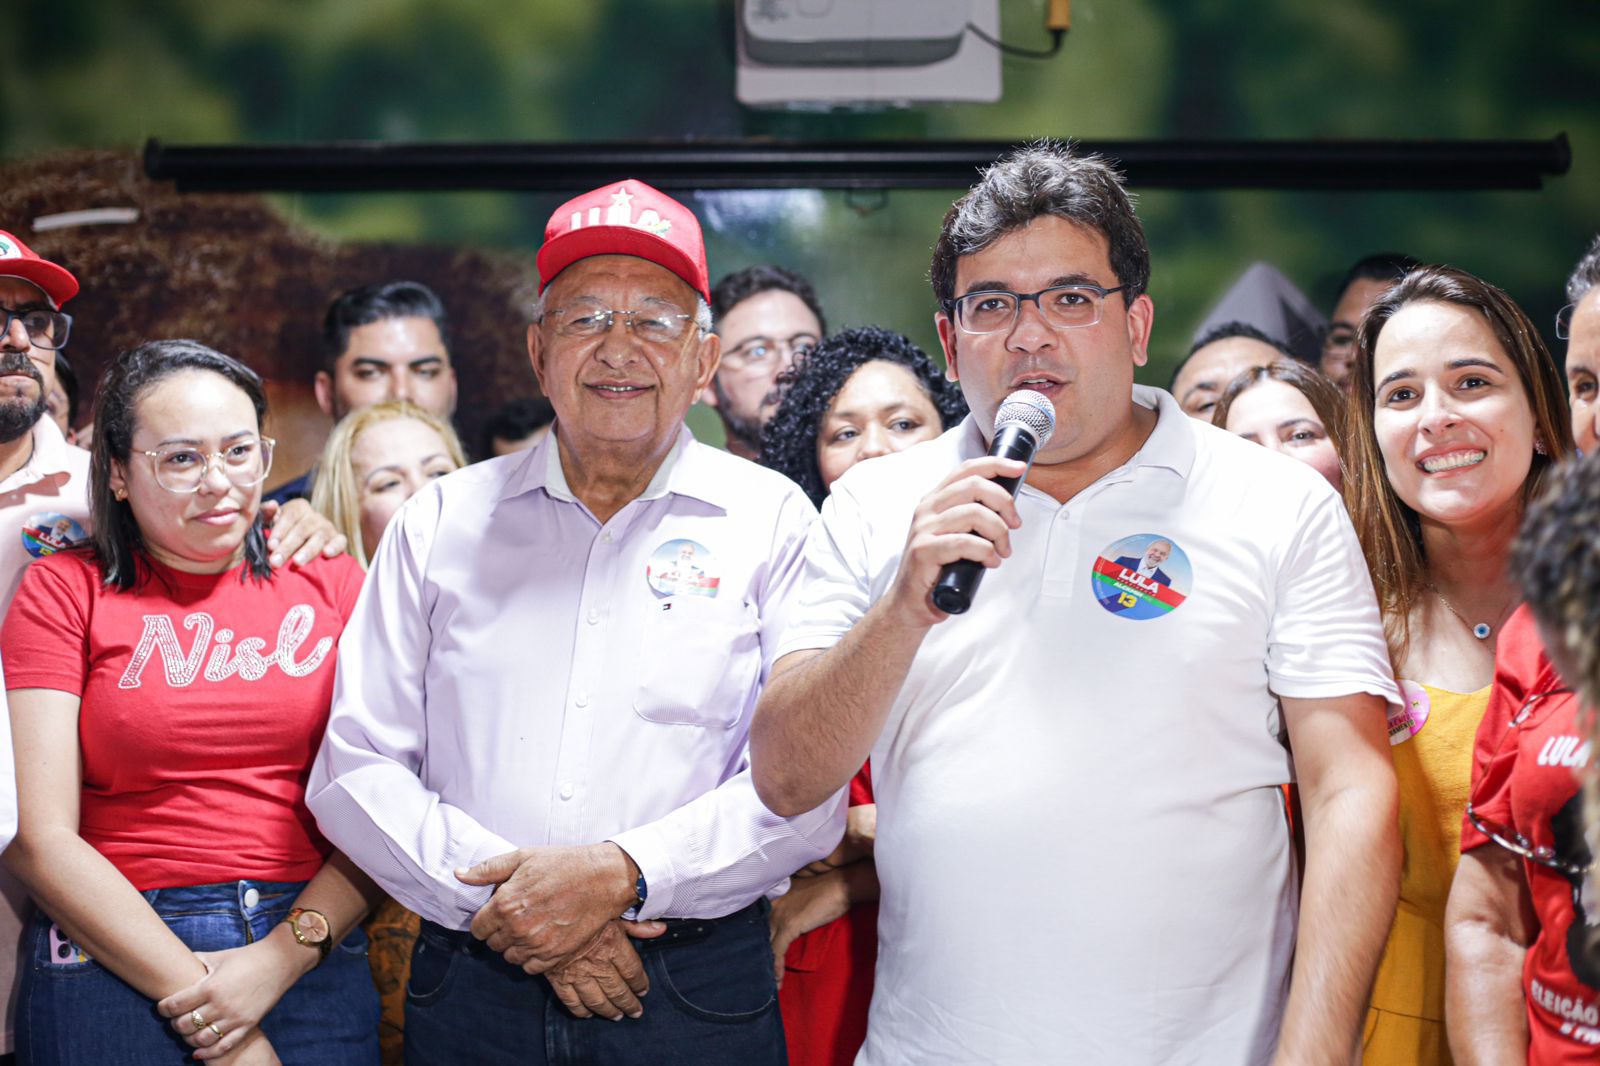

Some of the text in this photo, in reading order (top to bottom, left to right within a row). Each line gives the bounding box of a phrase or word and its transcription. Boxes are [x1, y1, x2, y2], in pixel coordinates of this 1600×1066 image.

[1118, 567, 1160, 594] LULA
[1117, 591, 1138, 608] 13
[1536, 735, 1593, 768] LULA
[1531, 978, 1599, 1026] ELEIÇÃO
